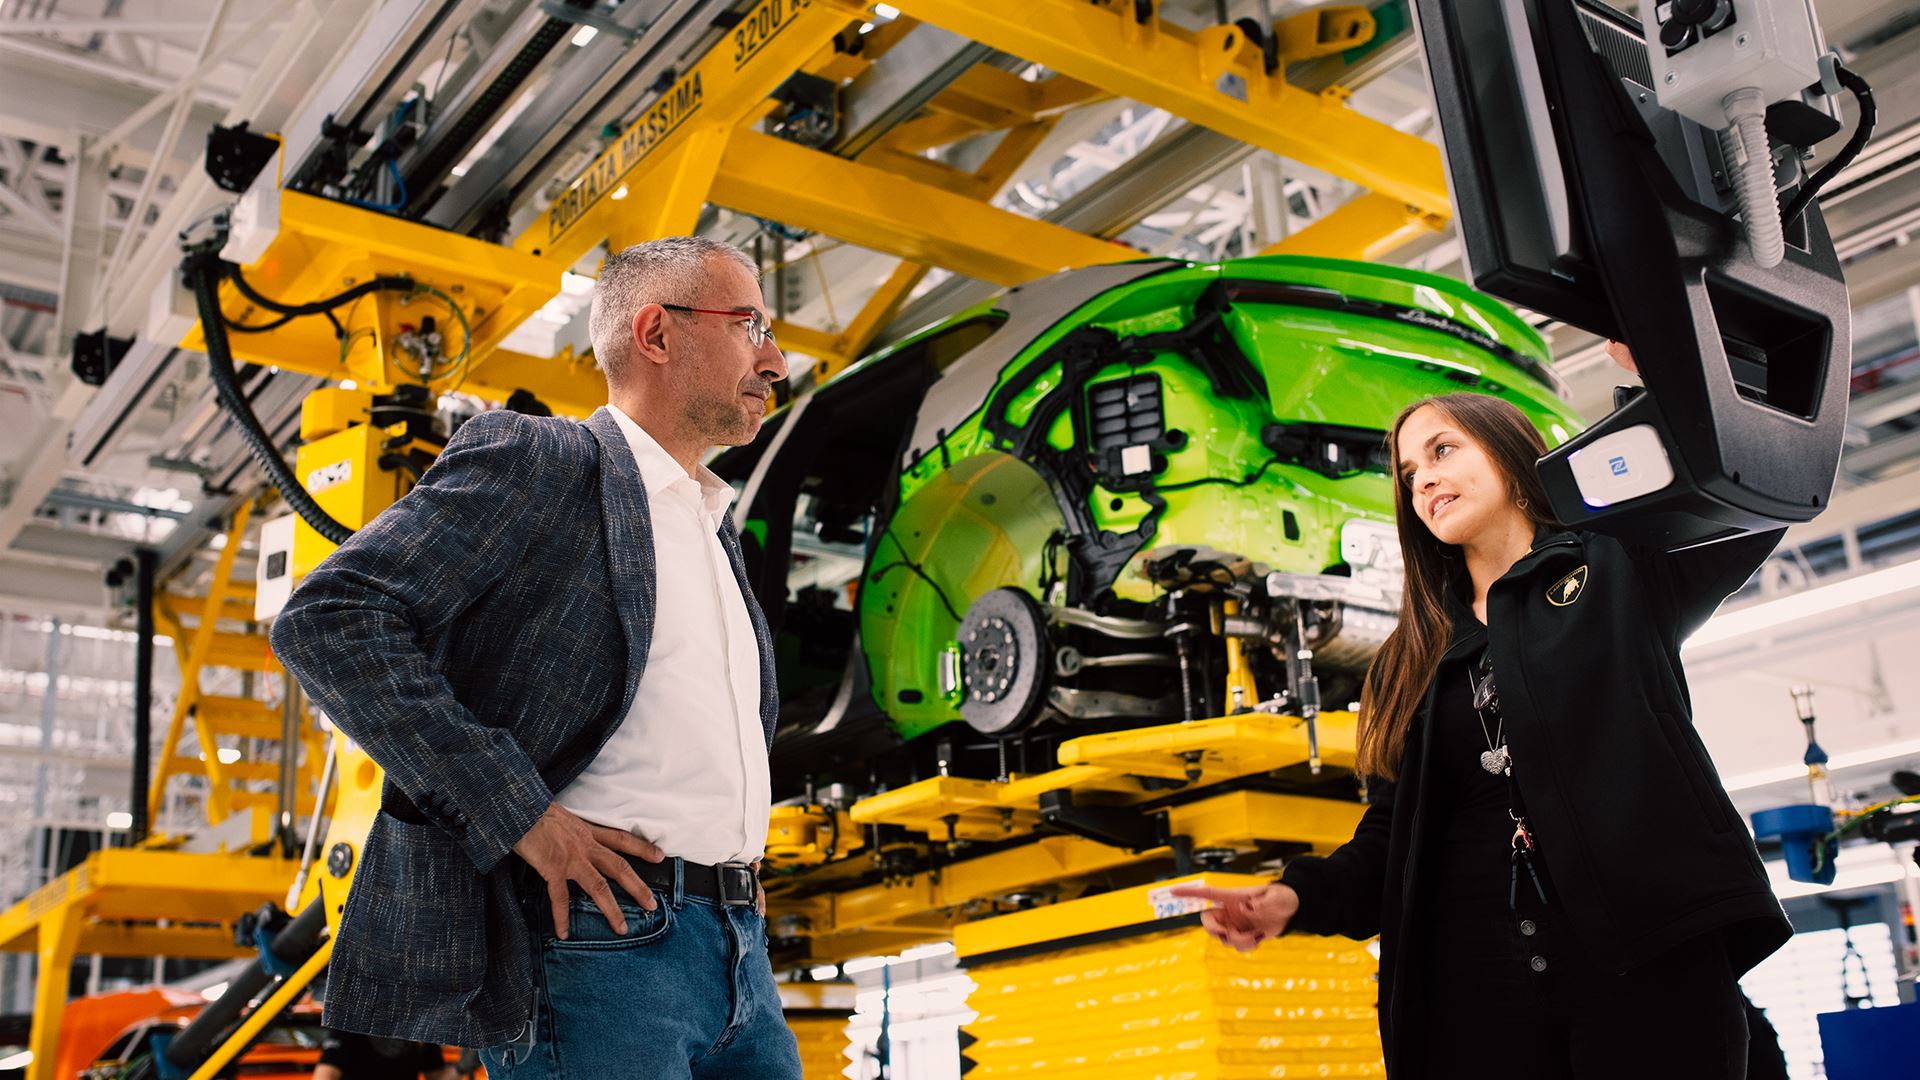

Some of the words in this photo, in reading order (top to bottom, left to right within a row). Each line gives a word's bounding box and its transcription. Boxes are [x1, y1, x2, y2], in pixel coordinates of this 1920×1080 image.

[549, 152, 616, 237] PORTATA
[621, 70, 703, 168] MASSIMA
[734, 0, 782, 62] 3200
